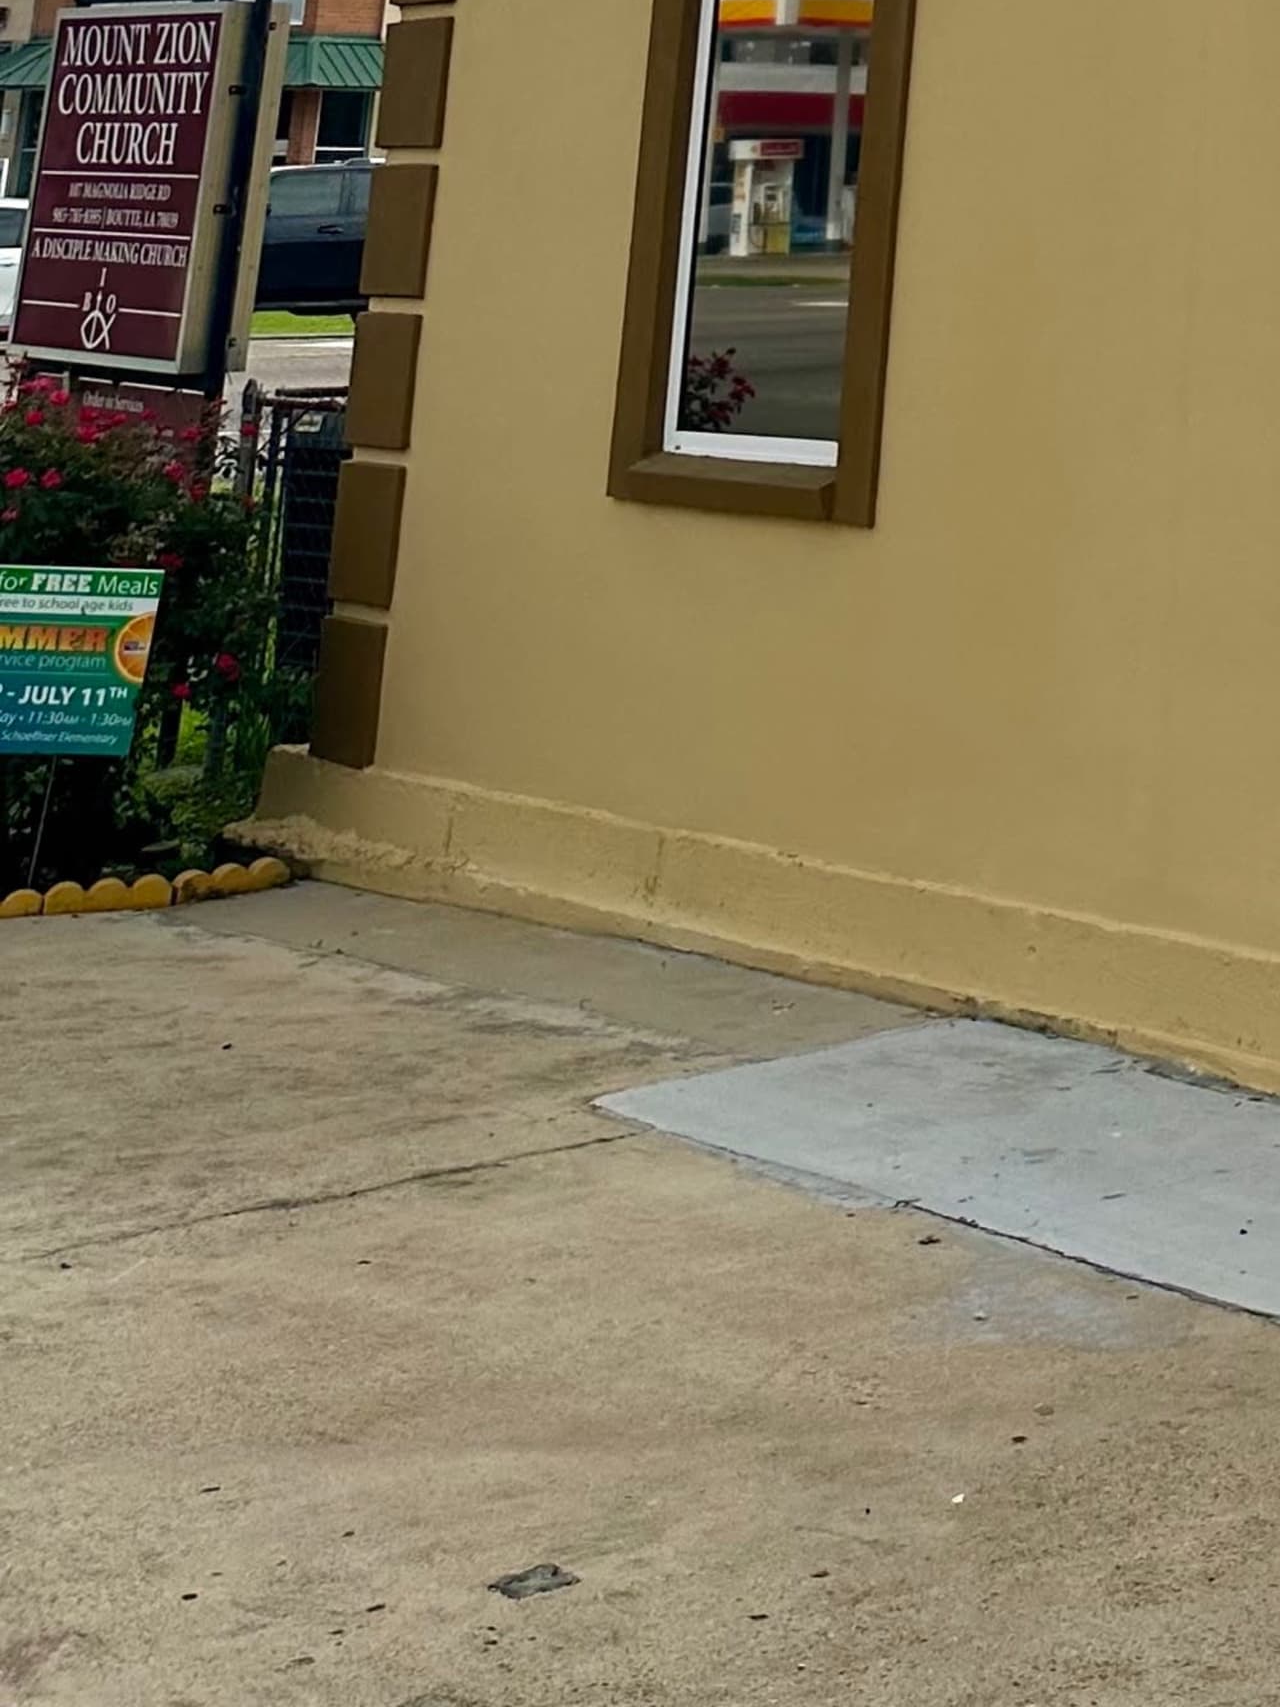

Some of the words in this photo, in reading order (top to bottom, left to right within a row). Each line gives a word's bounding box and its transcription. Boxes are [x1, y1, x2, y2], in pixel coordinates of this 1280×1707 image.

[62, 23, 150, 67] MOUNT
[153, 21, 216, 64] ZION
[58, 71, 209, 115] COMMUNITY
[76, 121, 178, 165] CHURCH
[144, 211, 156, 227] LA
[32, 237, 40, 258] A
[43, 238, 92, 260] DISCIPLE
[92, 240, 140, 264] MAKING
[141, 243, 188, 267] CHURCH
[30, 572, 93, 593] FREE
[97, 575, 158, 595] Meals
[22, 598, 35, 608] to
[38, 598, 80, 610] school
[83, 602, 105, 611] age
[108, 600, 133, 611] kids
[38, 654, 106, 672] program
[18, 685, 76, 705] JULY
